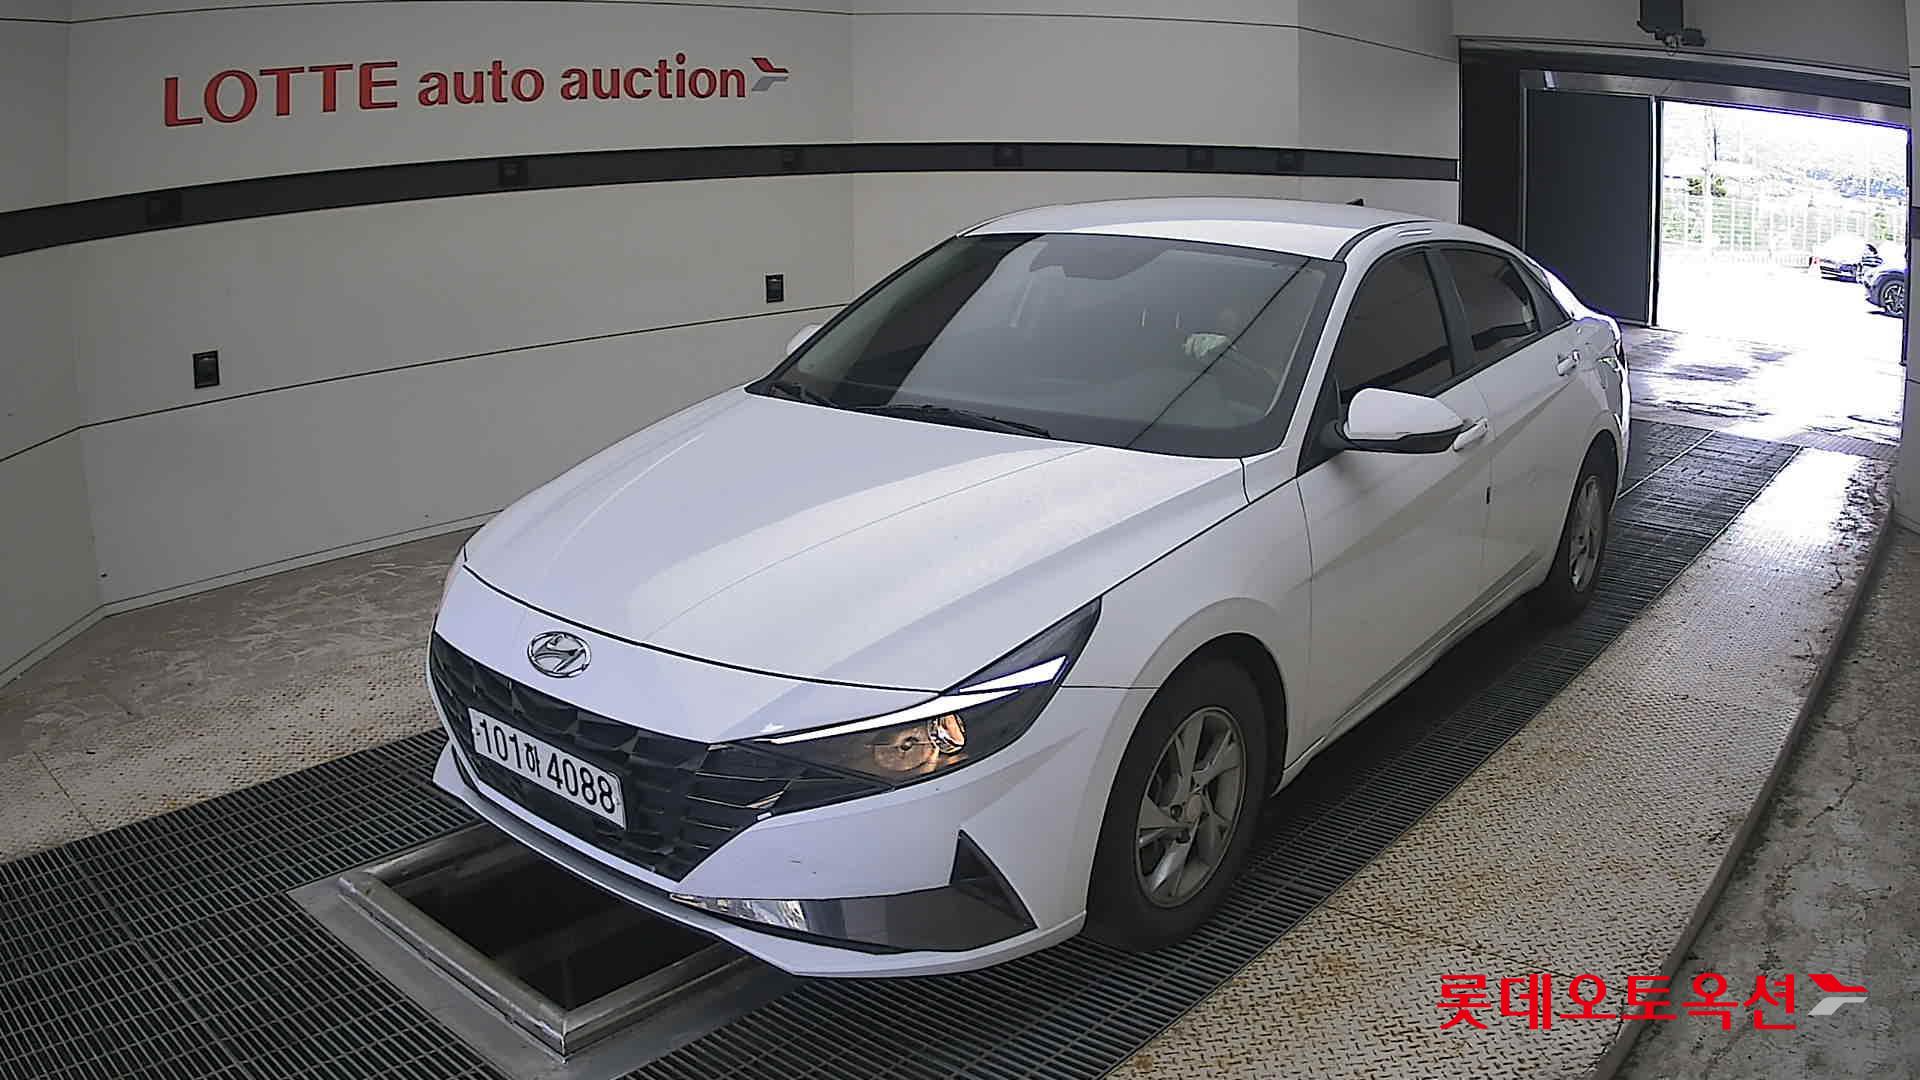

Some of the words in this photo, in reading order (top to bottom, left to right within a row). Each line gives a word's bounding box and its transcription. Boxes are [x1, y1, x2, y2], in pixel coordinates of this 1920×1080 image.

[164, 61, 398, 127] LOTTE
[417, 60, 545, 106] auto
[560, 53, 747, 99] auction
[547, 753, 616, 815] 4088
